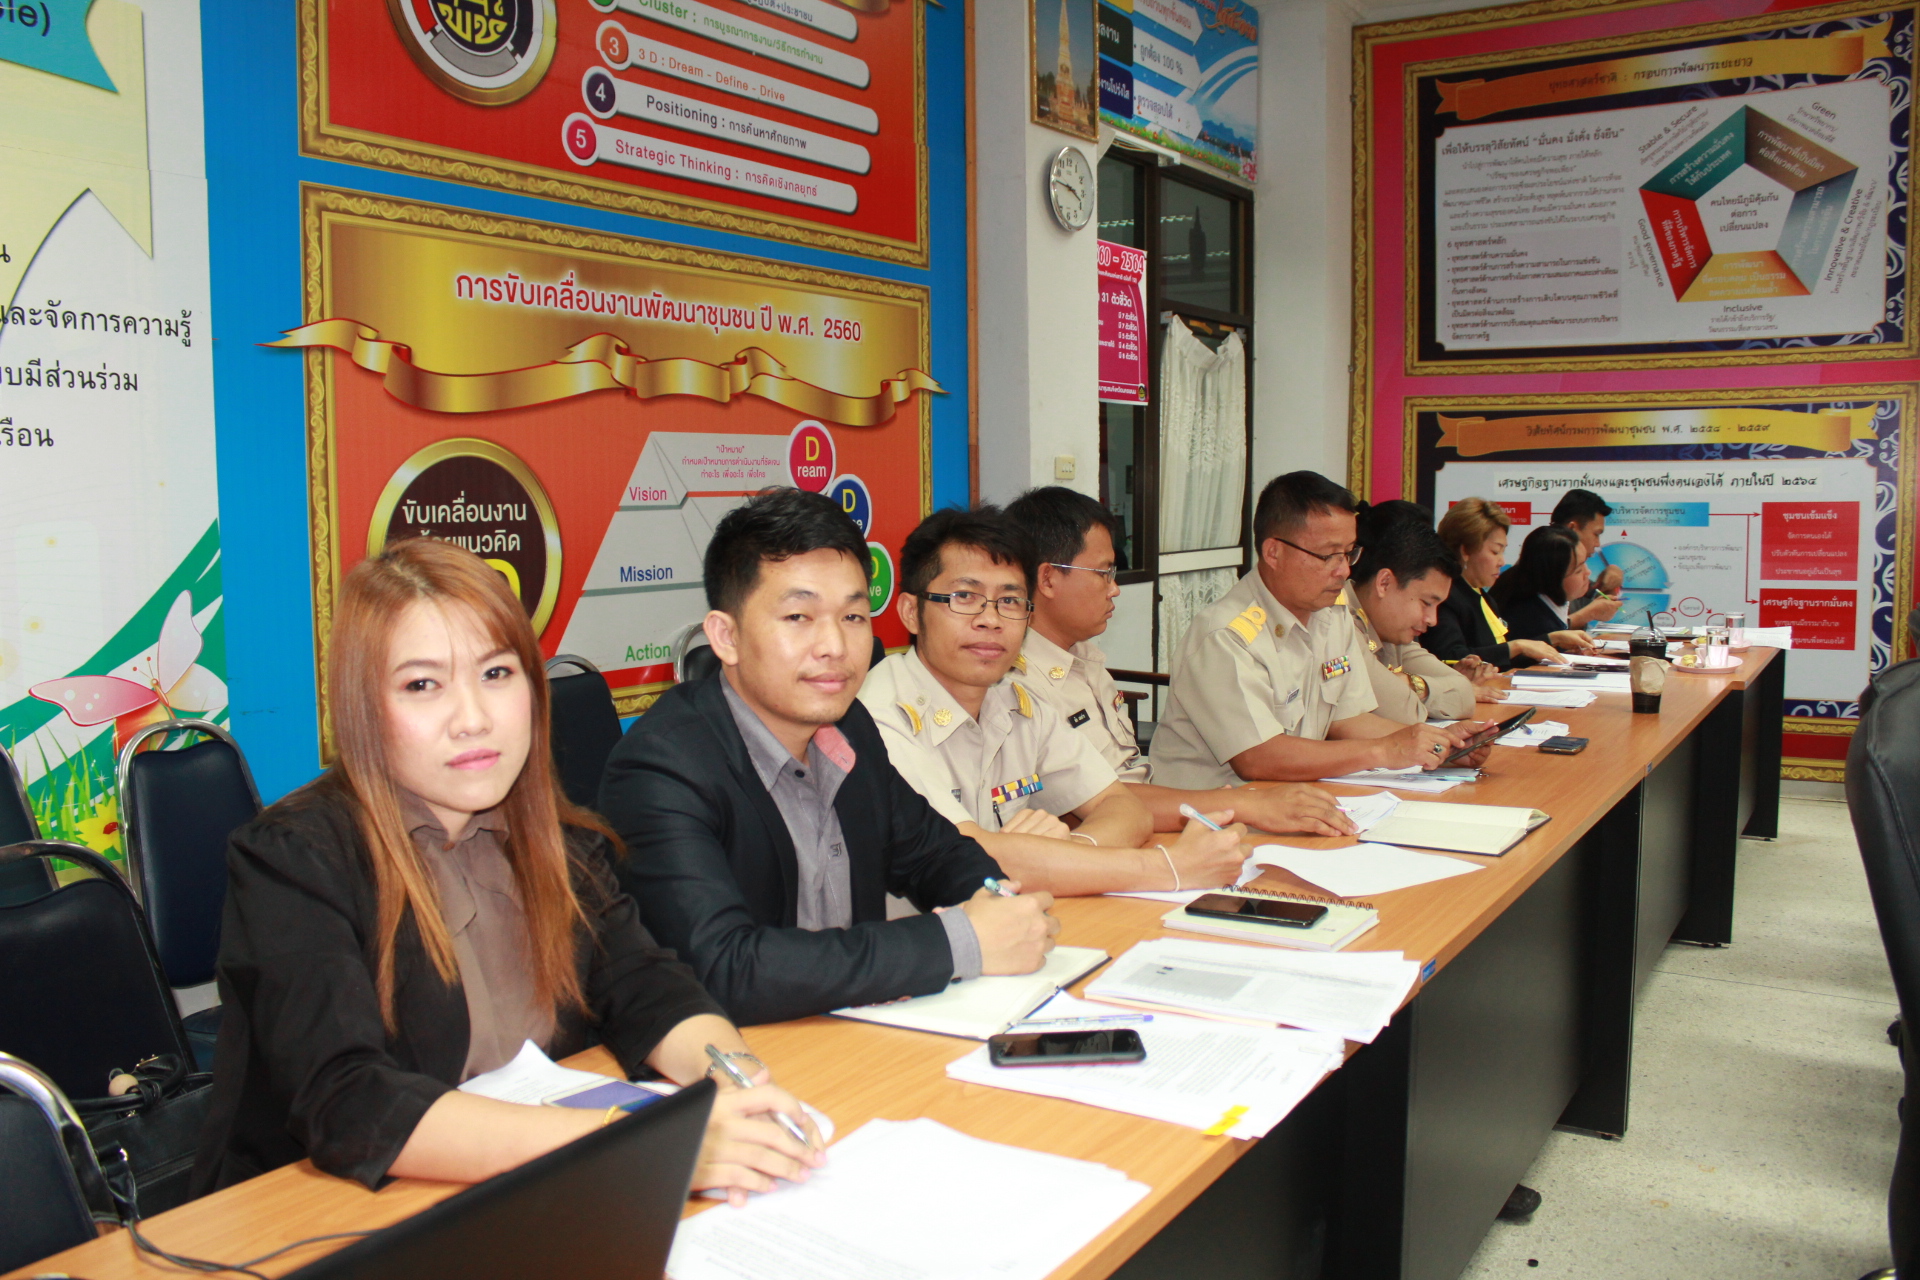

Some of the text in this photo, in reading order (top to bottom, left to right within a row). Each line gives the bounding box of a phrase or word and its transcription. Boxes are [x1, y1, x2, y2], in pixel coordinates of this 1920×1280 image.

[609, 36, 620, 56] 3
[638, 48, 646, 60] 3
[649, 51, 658, 64] D
[669, 57, 703, 78] Dream
[716, 71, 749, 91] Define
[760, 84, 786, 102] Drive
[594, 82, 607, 102] 4
[646, 94, 719, 129] Positioning
[1811, 101, 1837, 121] Green
[1637, 132, 1664, 154] Stable
[1670, 104, 1699, 127] Secure
[575, 128, 588, 149] 5
[615, 138, 676, 166] Strategic
[680, 153, 732, 181] Thinking
[1637, 218, 1650, 242] Good
[1824, 236, 1847, 283] Innovative
[1846, 188, 1864, 226] Creative
[1120, 250, 1145, 275] 2564
[1643, 239, 1665, 289] governance
[456, 271, 862, 342] การขับเคลื่อนงานพัฒนาชุมชน ปี พ.ศ. 2560
[1723, 303, 1763, 313] Inclusive
[0, 358, 139, 391] บมีส่วนร่วม
[0, 417, 55, 447] รือน
[804, 436, 821, 461] D
[797, 464, 827, 478] ream
[628, 486, 668, 501] Vision
[842, 488, 856, 513] D
[402, 490, 528, 525] ขับเคลื่อนงาน
[619, 565, 673, 583] Mission
[625, 643, 672, 663] Action
